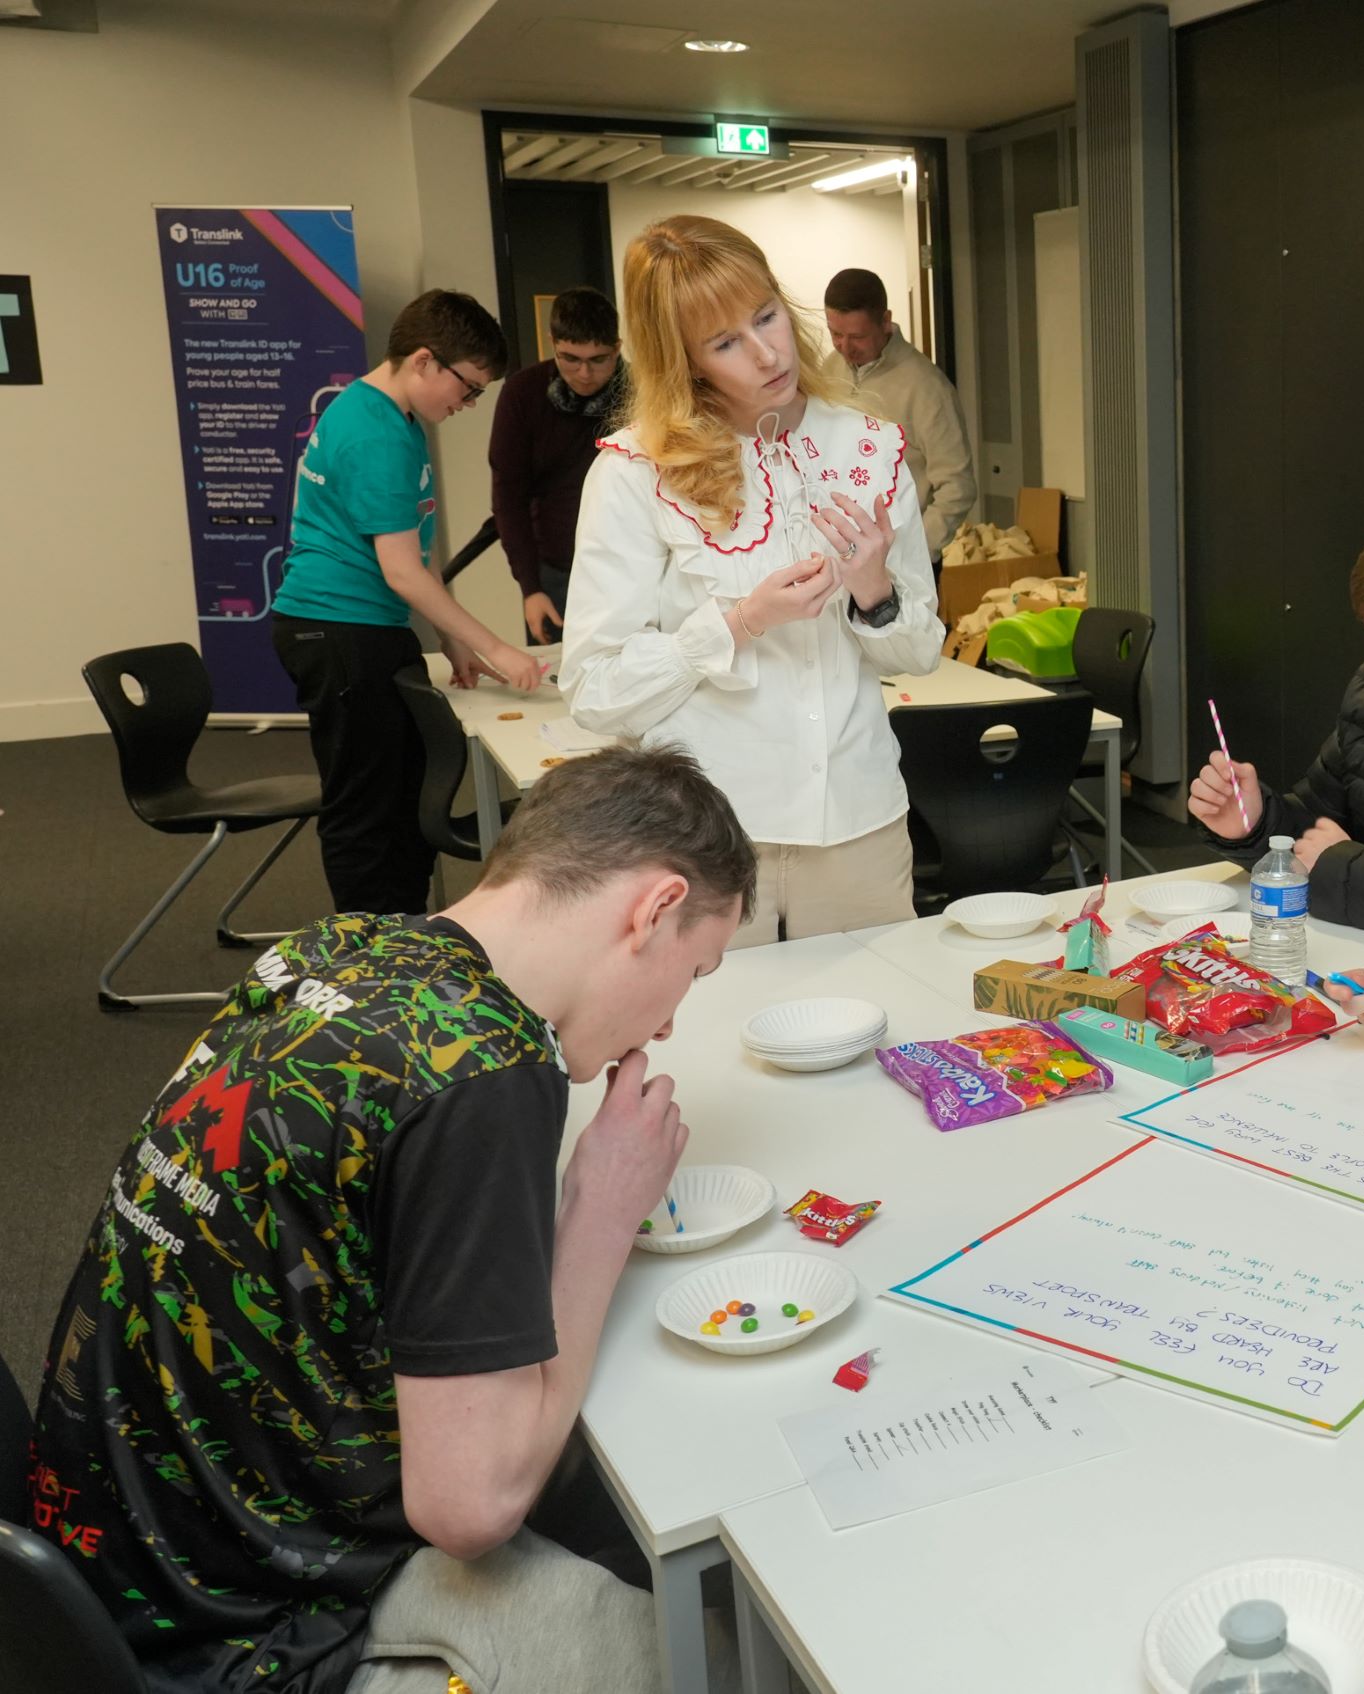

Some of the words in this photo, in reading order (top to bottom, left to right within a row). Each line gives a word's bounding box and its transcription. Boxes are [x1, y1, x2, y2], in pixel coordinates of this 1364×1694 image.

[190, 228, 243, 240] Translink
[176, 263, 225, 287] U16
[229, 264, 258, 273] Proof
[231, 278, 243, 287] of
[244, 279, 265, 290] Age
[189, 298, 218, 308] SHOW
[219, 299, 241, 309] AND
[242, 299, 257, 309] GO
[201, 310, 225, 319] WITH
[184, 339, 199, 348] The
[220, 340, 257, 348] Translink
[269, 342, 287, 350] app
[288, 340, 301, 348] for
[185, 352, 211, 362] young
[214, 352, 244, 361] people
[245, 352, 269, 362] aged
[186, 367, 210, 376] Prove
[211, 370, 230, 378] your
[231, 370, 248, 378] age
[249, 368, 262, 376] for
[263, 368, 281, 376] half
[187, 380, 208, 389] price
[210, 380, 225, 388] bus
[235, 380, 256, 388] train
[221, 402, 257, 410] download
[295, 978, 354, 1021] ORR
[1186, 1115, 1215, 1129] FOR
[1215, 1112, 1289, 1143] INFLUENCE
[1271, 1147, 1313, 1163] BEST
[1299, 1143, 1319, 1154] TO
[1320, 1164, 1350, 1178] THE
[174, 1168, 220, 1217] MEDIA
[983, 1283, 1047, 1310] VIEWS
[1032, 1279, 1151, 1320] TRANSPORT
[1063, 1306, 1122, 1331] YOUR
[1149, 1330, 1197, 1354] FEEL
[1211, 1332, 1273, 1357] HEARD
[1298, 1356, 1340, 1375] ARE
[1288, 1376, 1323, 1396] DO
